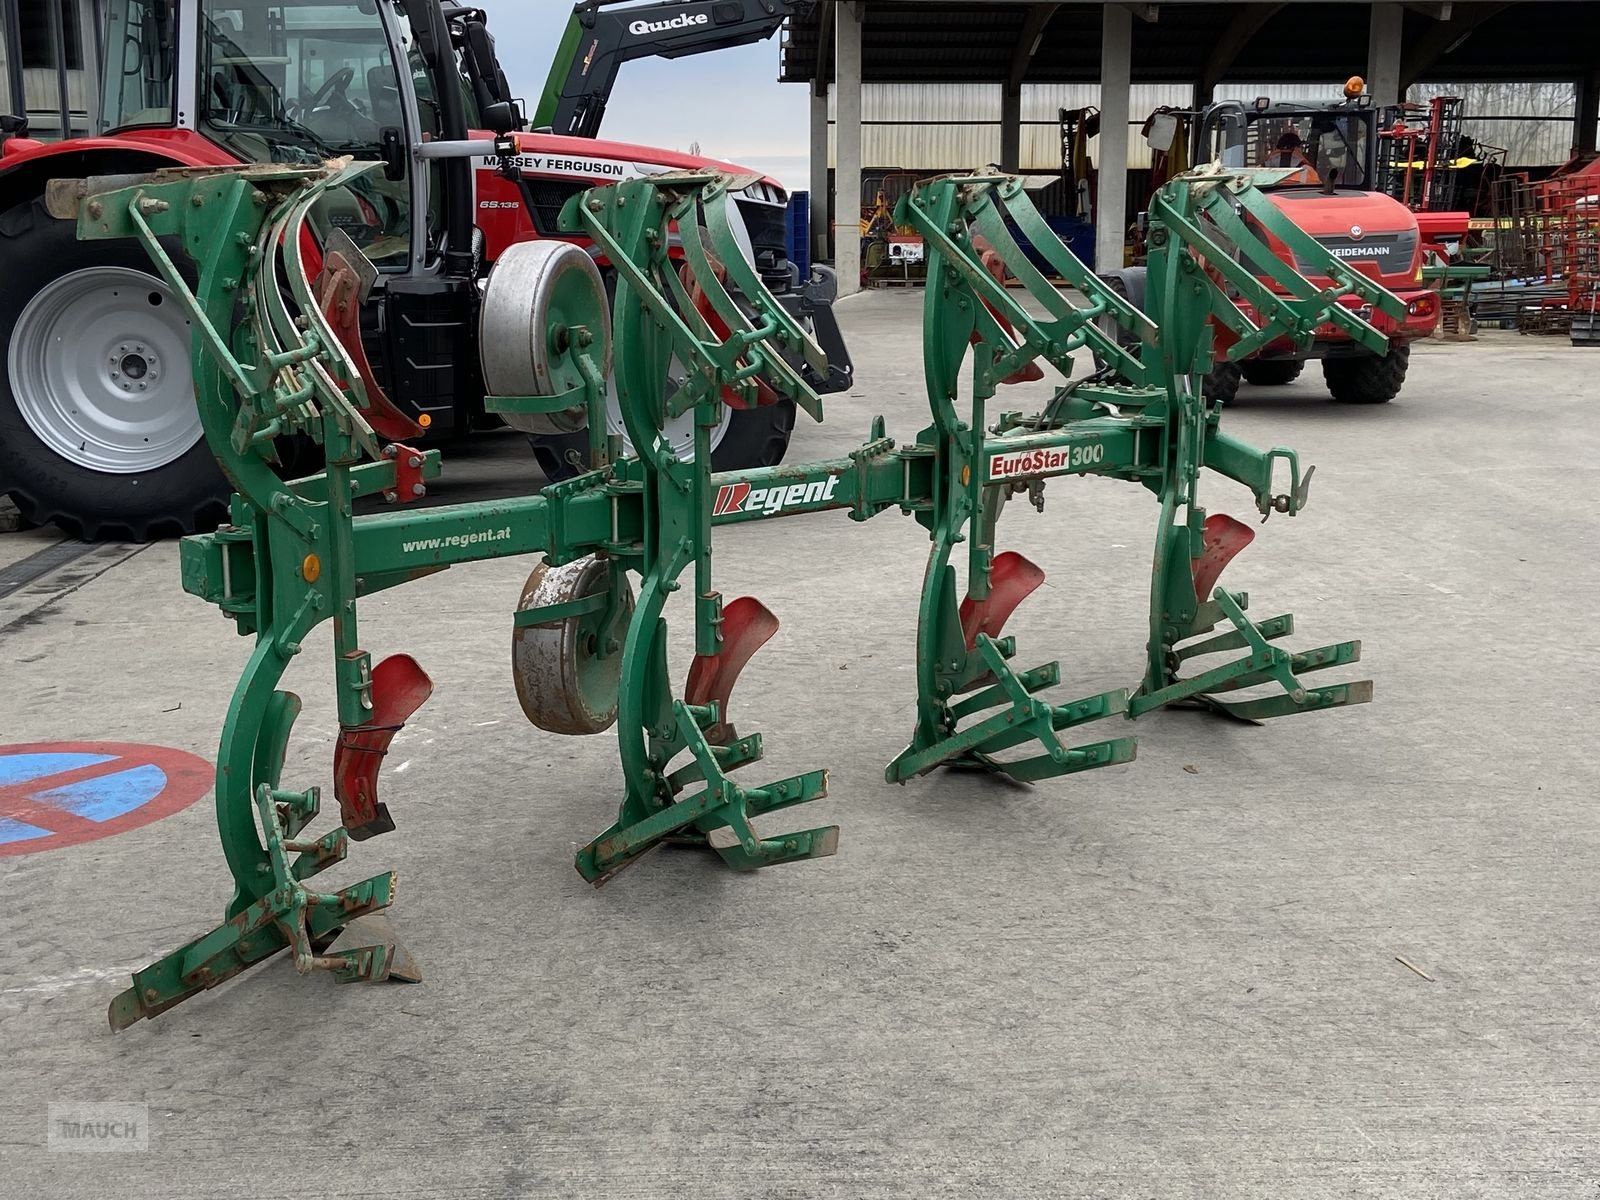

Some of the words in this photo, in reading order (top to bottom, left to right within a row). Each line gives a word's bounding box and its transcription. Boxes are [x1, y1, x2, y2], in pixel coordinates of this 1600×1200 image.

[629, 13, 708, 35] Quicke
[547, 159, 624, 175] FERGUSON
[1071, 443, 1104, 466] 300
[712, 475, 839, 516] Regent
[403, 526, 511, 552] www.regent.at
